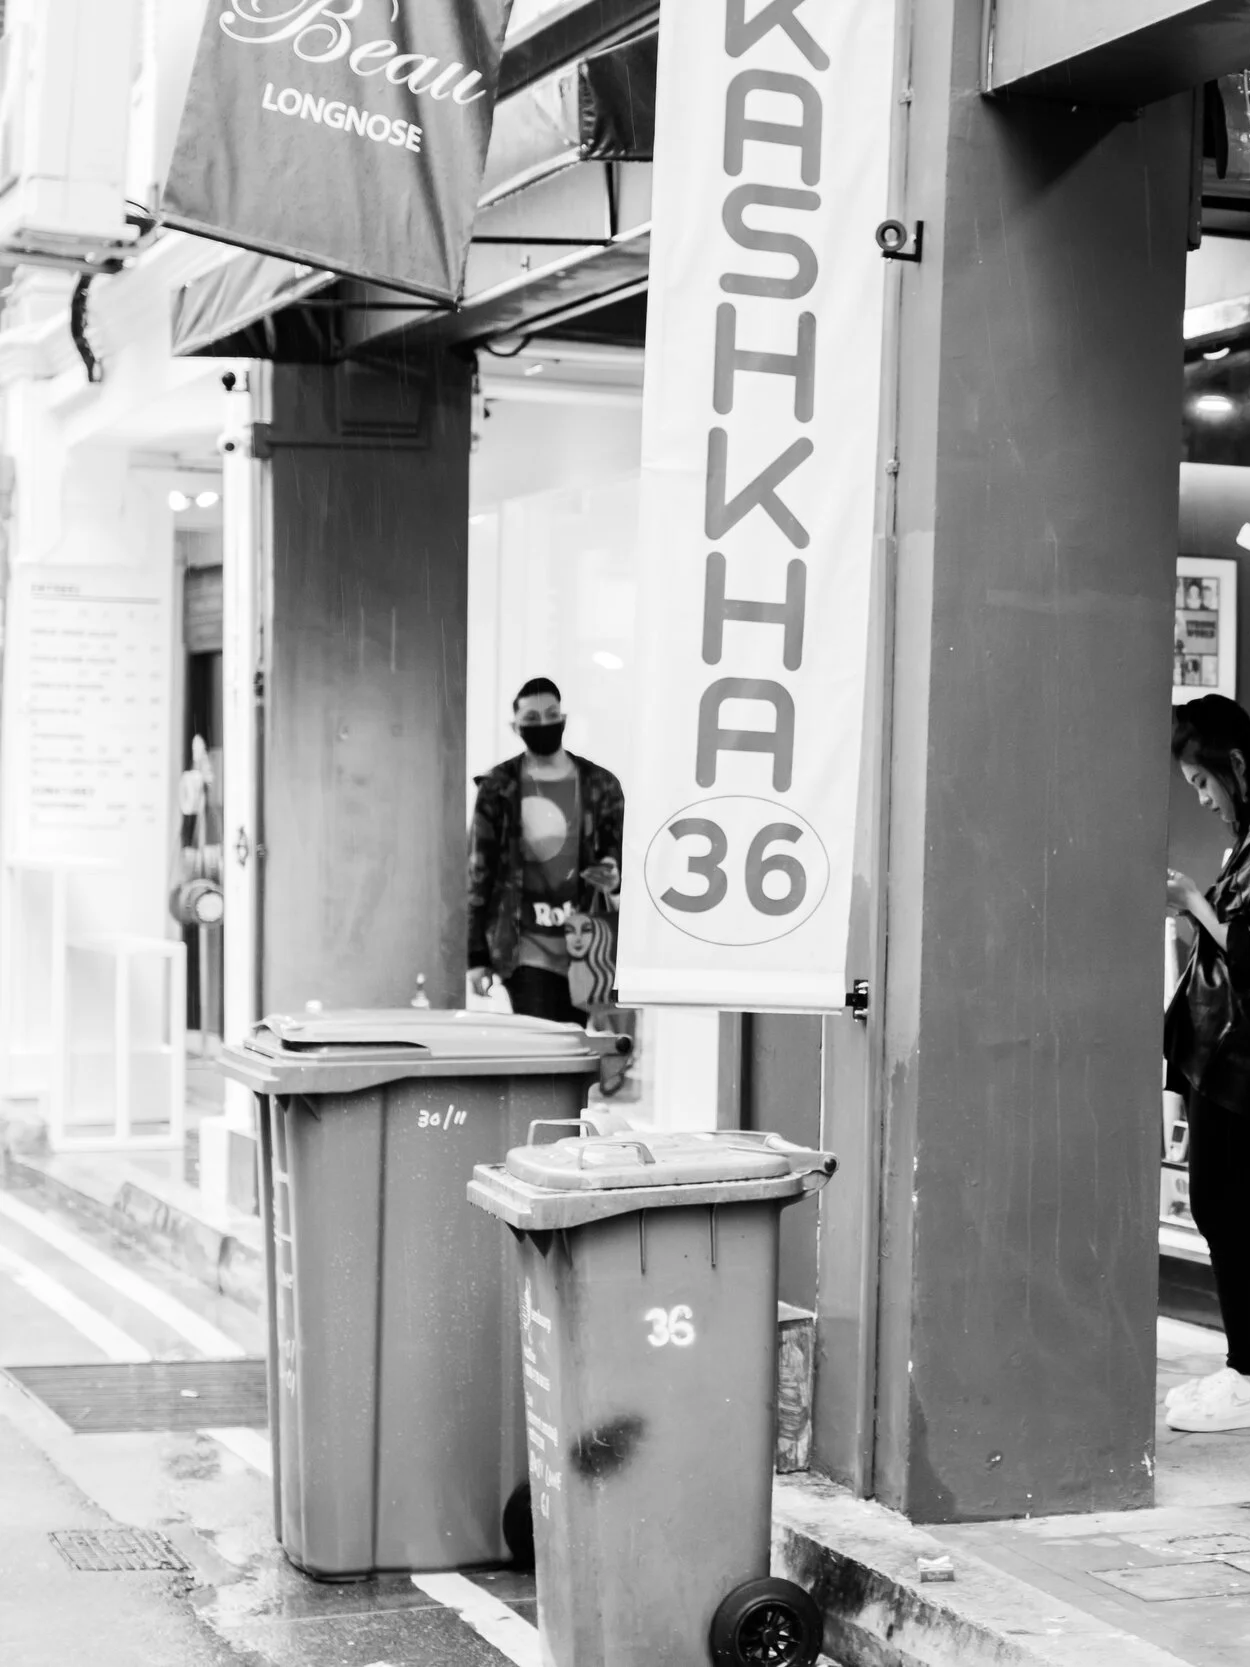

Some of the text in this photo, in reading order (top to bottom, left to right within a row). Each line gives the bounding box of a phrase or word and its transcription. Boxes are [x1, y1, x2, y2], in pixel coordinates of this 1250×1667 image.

[219, 0, 487, 105] Beau
[261, 82, 423, 153] LONGNOSE
[660, 817, 807, 917] 36
[644, 1303, 696, 1348] 36
